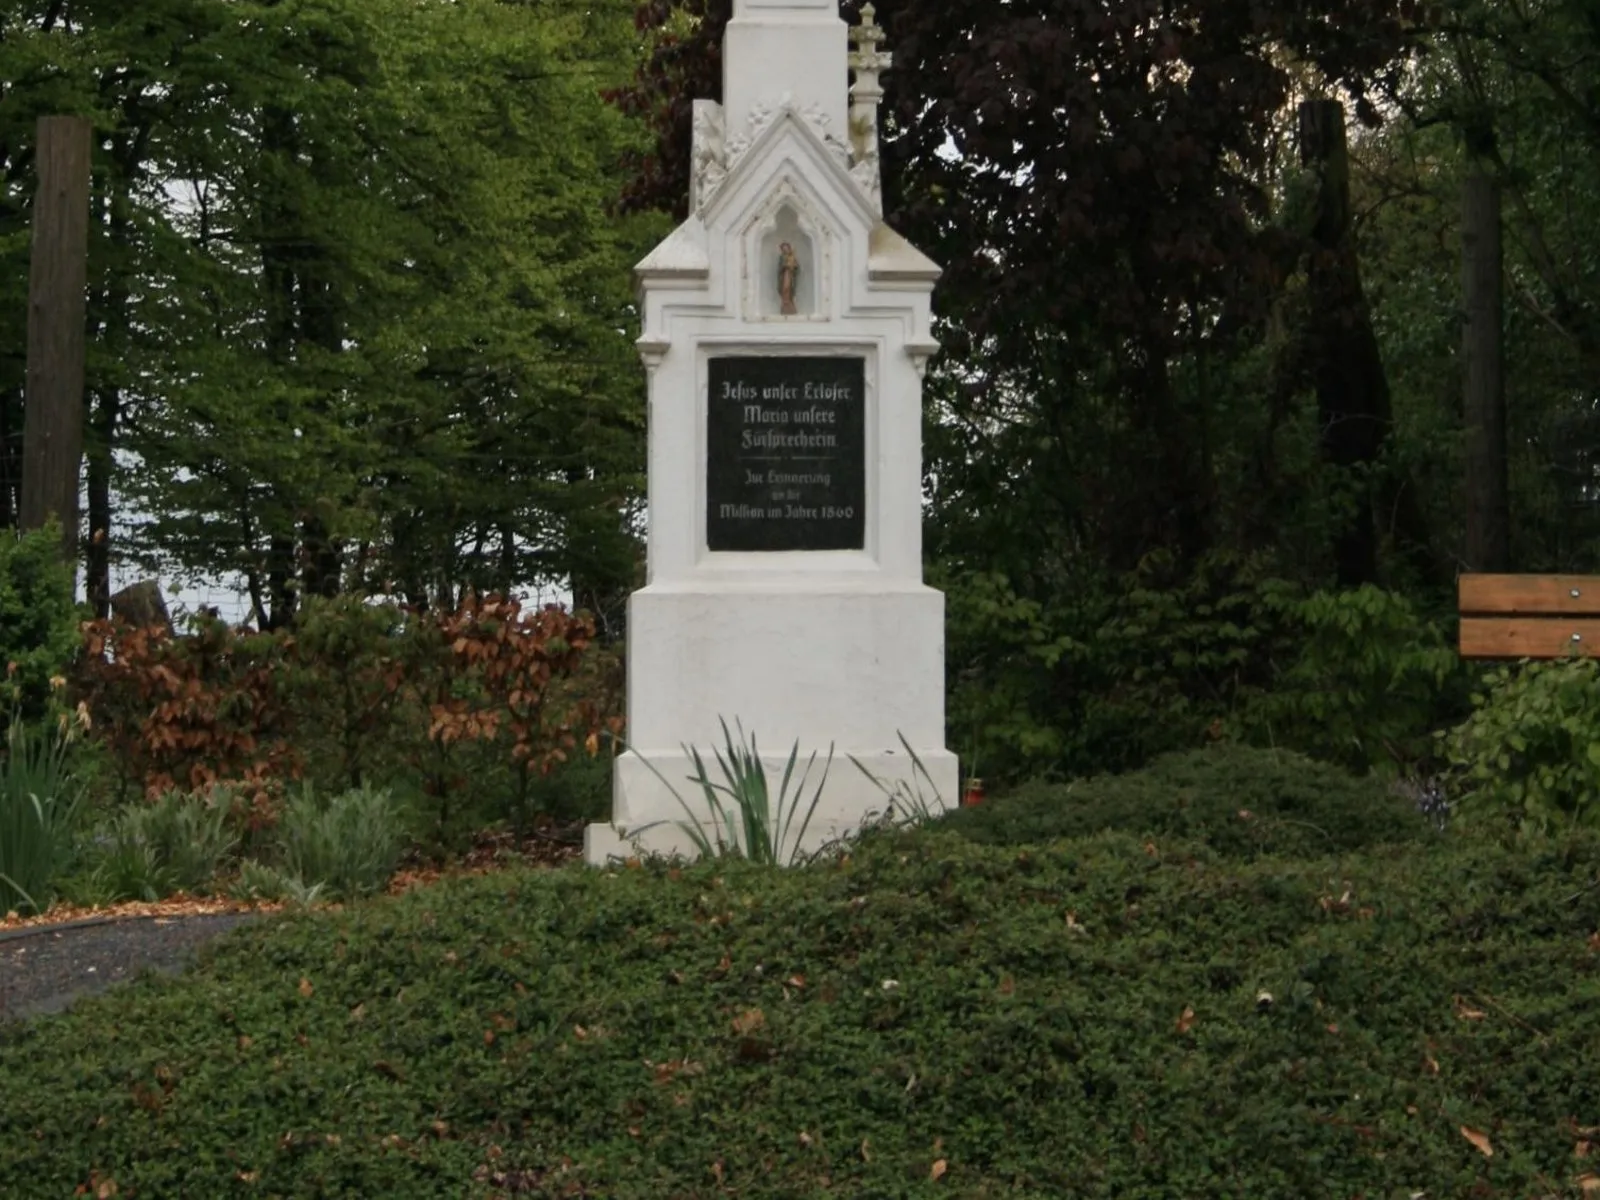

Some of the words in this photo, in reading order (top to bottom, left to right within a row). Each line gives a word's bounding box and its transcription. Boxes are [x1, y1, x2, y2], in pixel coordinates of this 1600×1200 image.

[722, 380, 758, 402] Jesus
[762, 382, 799, 402] unser
[744, 404, 789, 424] Maria
[794, 404, 836, 424] unsere
[767, 468, 831, 487] Erinnerung
[720, 504, 765, 519] Mission
[784, 504, 817, 519] Jahre
